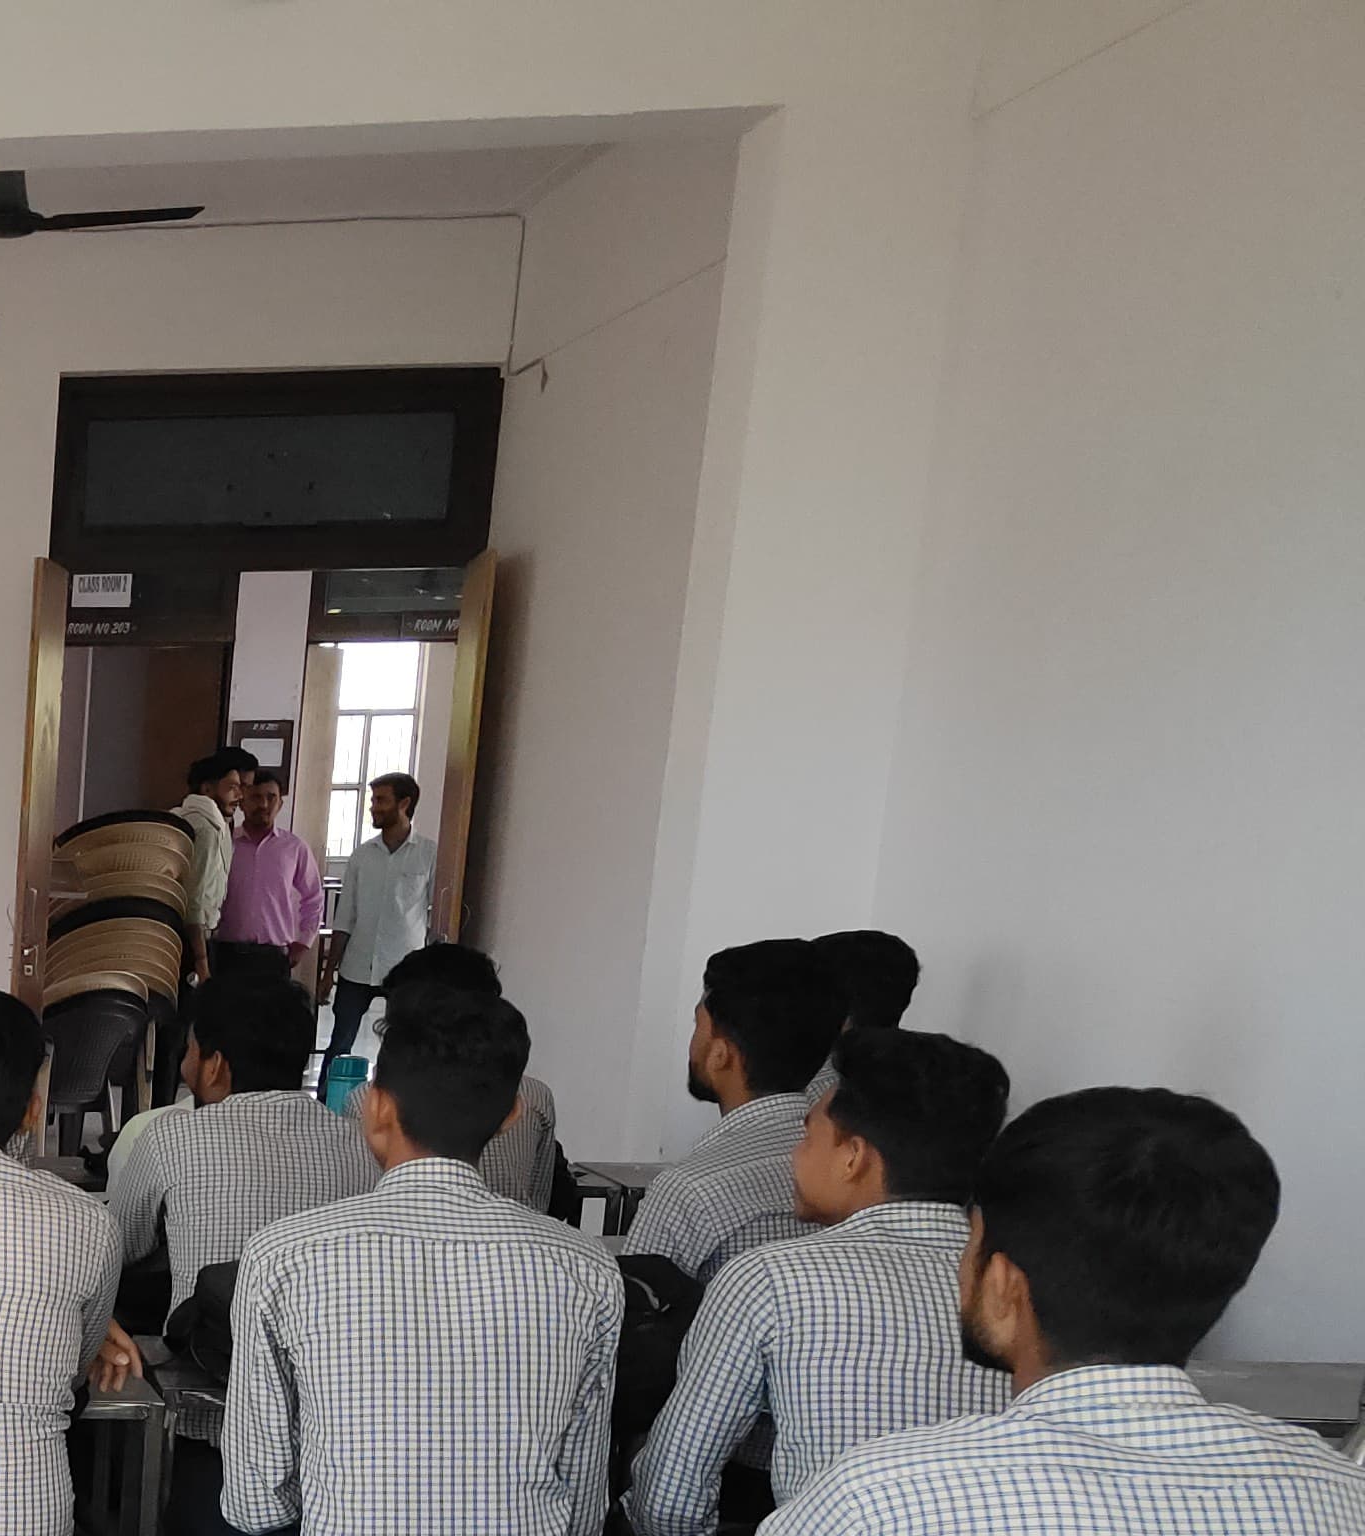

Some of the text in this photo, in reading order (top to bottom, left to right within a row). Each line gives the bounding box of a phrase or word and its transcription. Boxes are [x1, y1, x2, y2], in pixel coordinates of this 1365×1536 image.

[77, 575, 100, 594] CLASS
[67, 621, 131, 635] ROOM NO 203
[414, 618, 443, 633] ROOM
